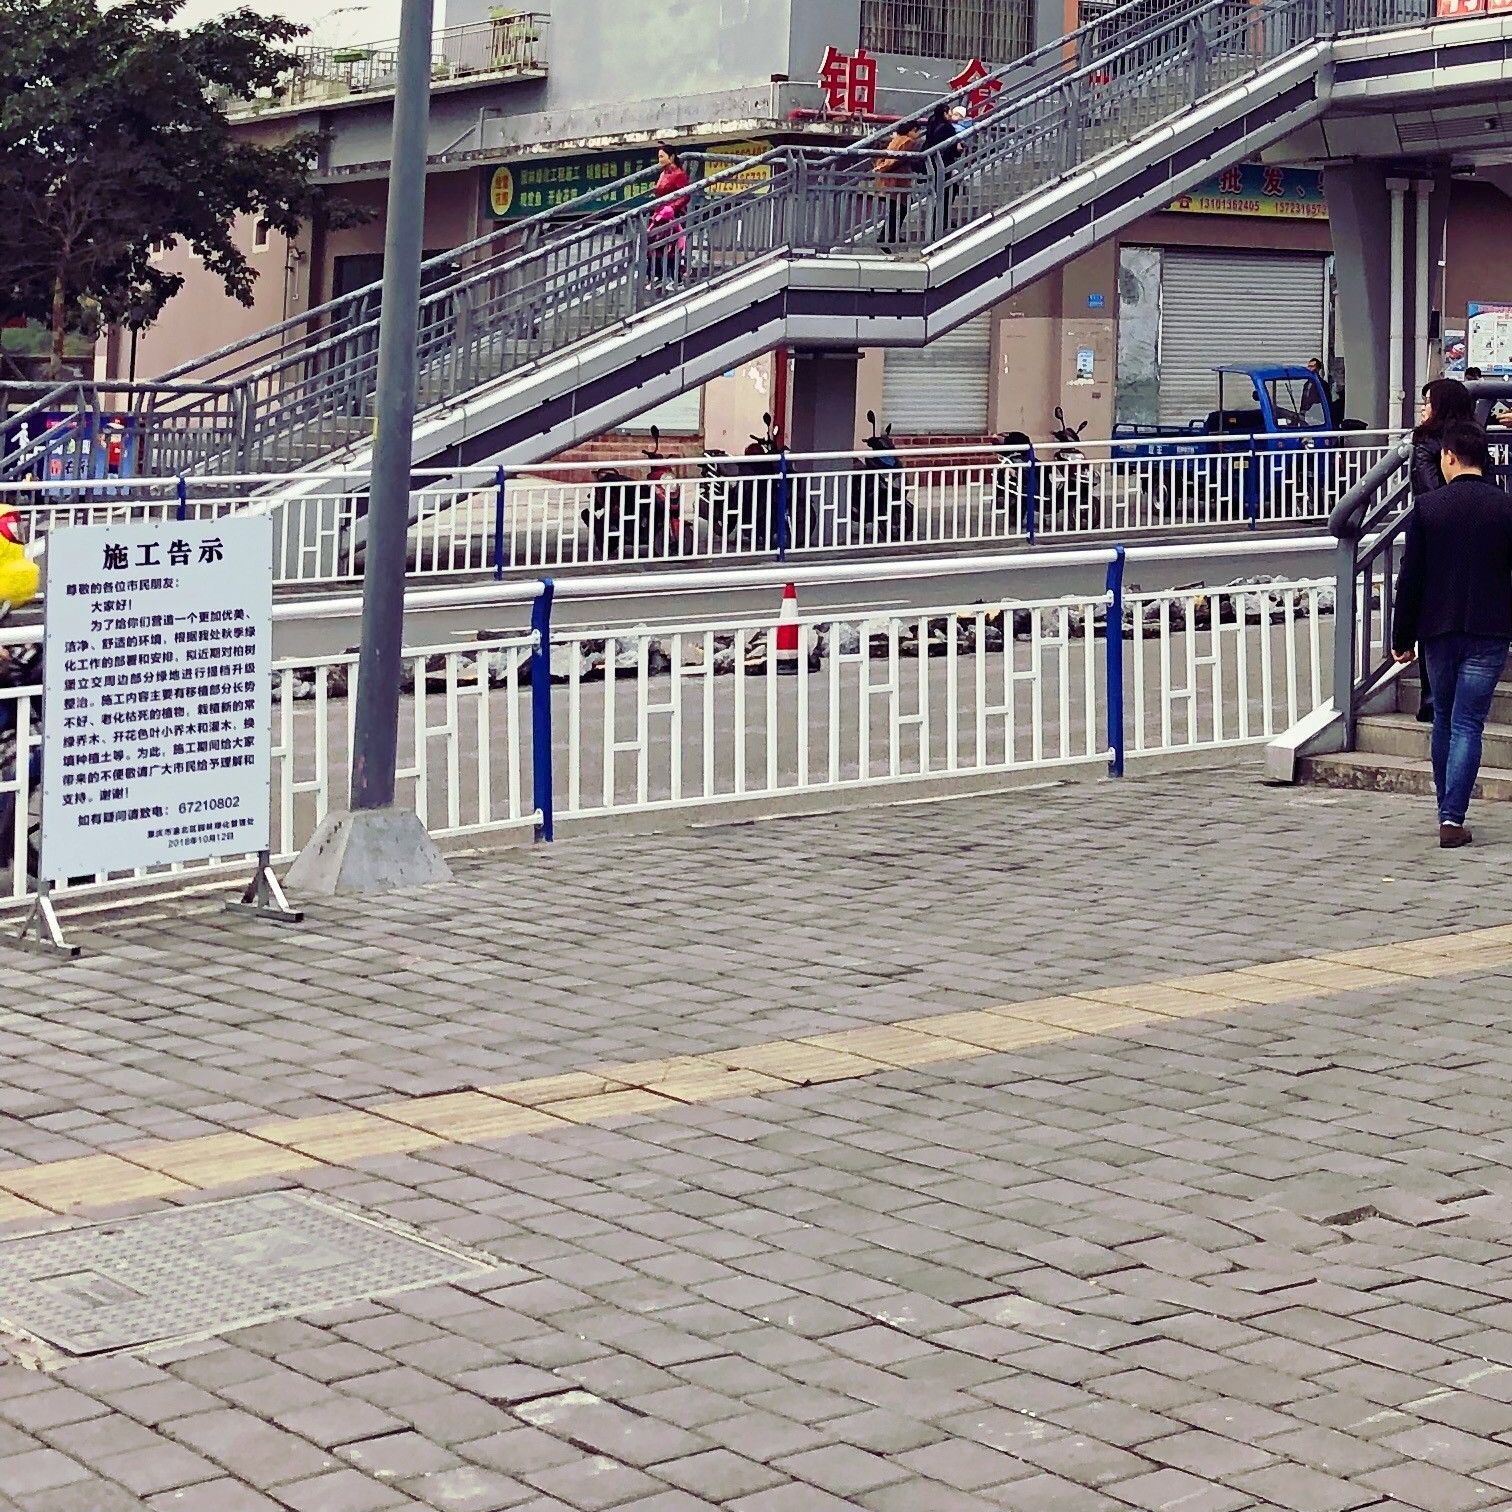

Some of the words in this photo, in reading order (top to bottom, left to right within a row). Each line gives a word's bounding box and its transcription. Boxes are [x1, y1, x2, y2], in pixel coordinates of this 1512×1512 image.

[102, 537, 224, 570] 施工告示
[66, 577, 180, 596] 尊敬的各位市民朋友：
[91, 599, 132, 613] 大家好！
[178, 795, 240, 814] 67210802
